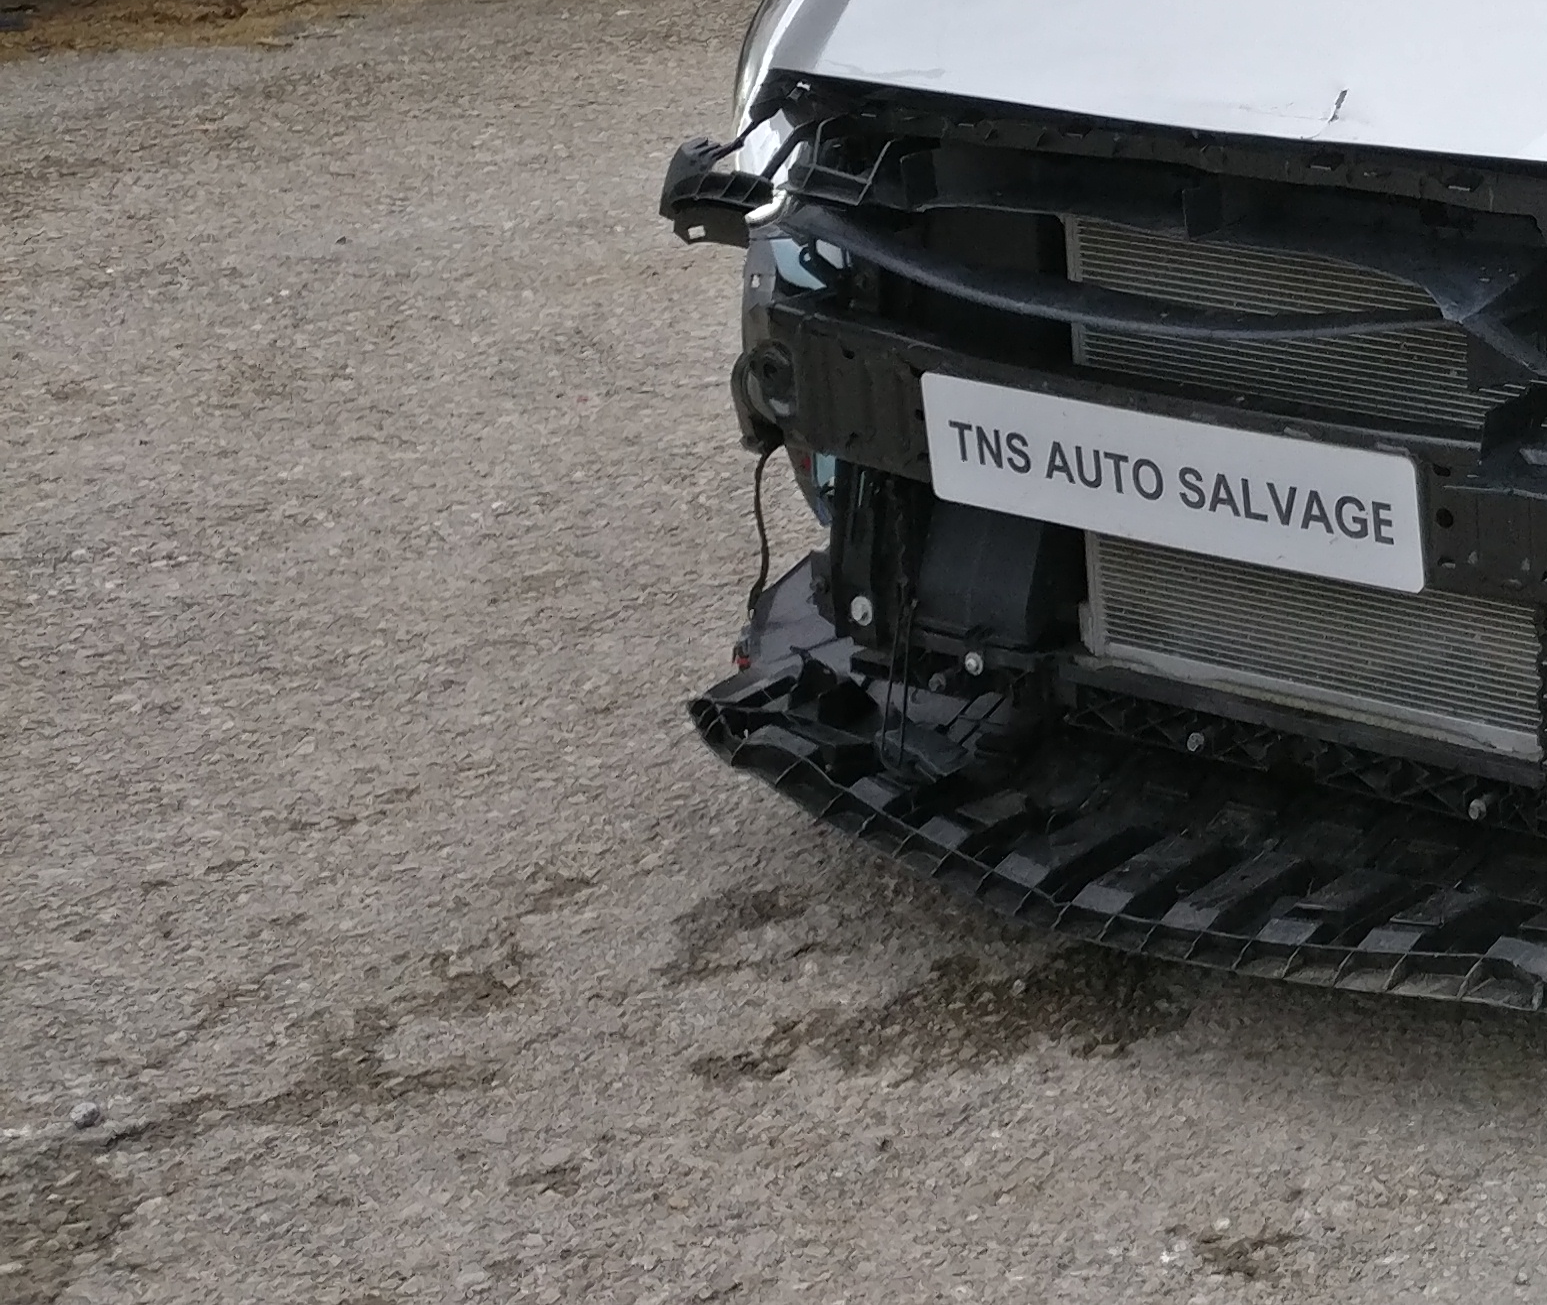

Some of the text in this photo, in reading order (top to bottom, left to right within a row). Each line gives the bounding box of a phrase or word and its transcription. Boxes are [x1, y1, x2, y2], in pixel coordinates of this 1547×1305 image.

[948, 419, 1395, 546] TNS AUTO SALVAGE
